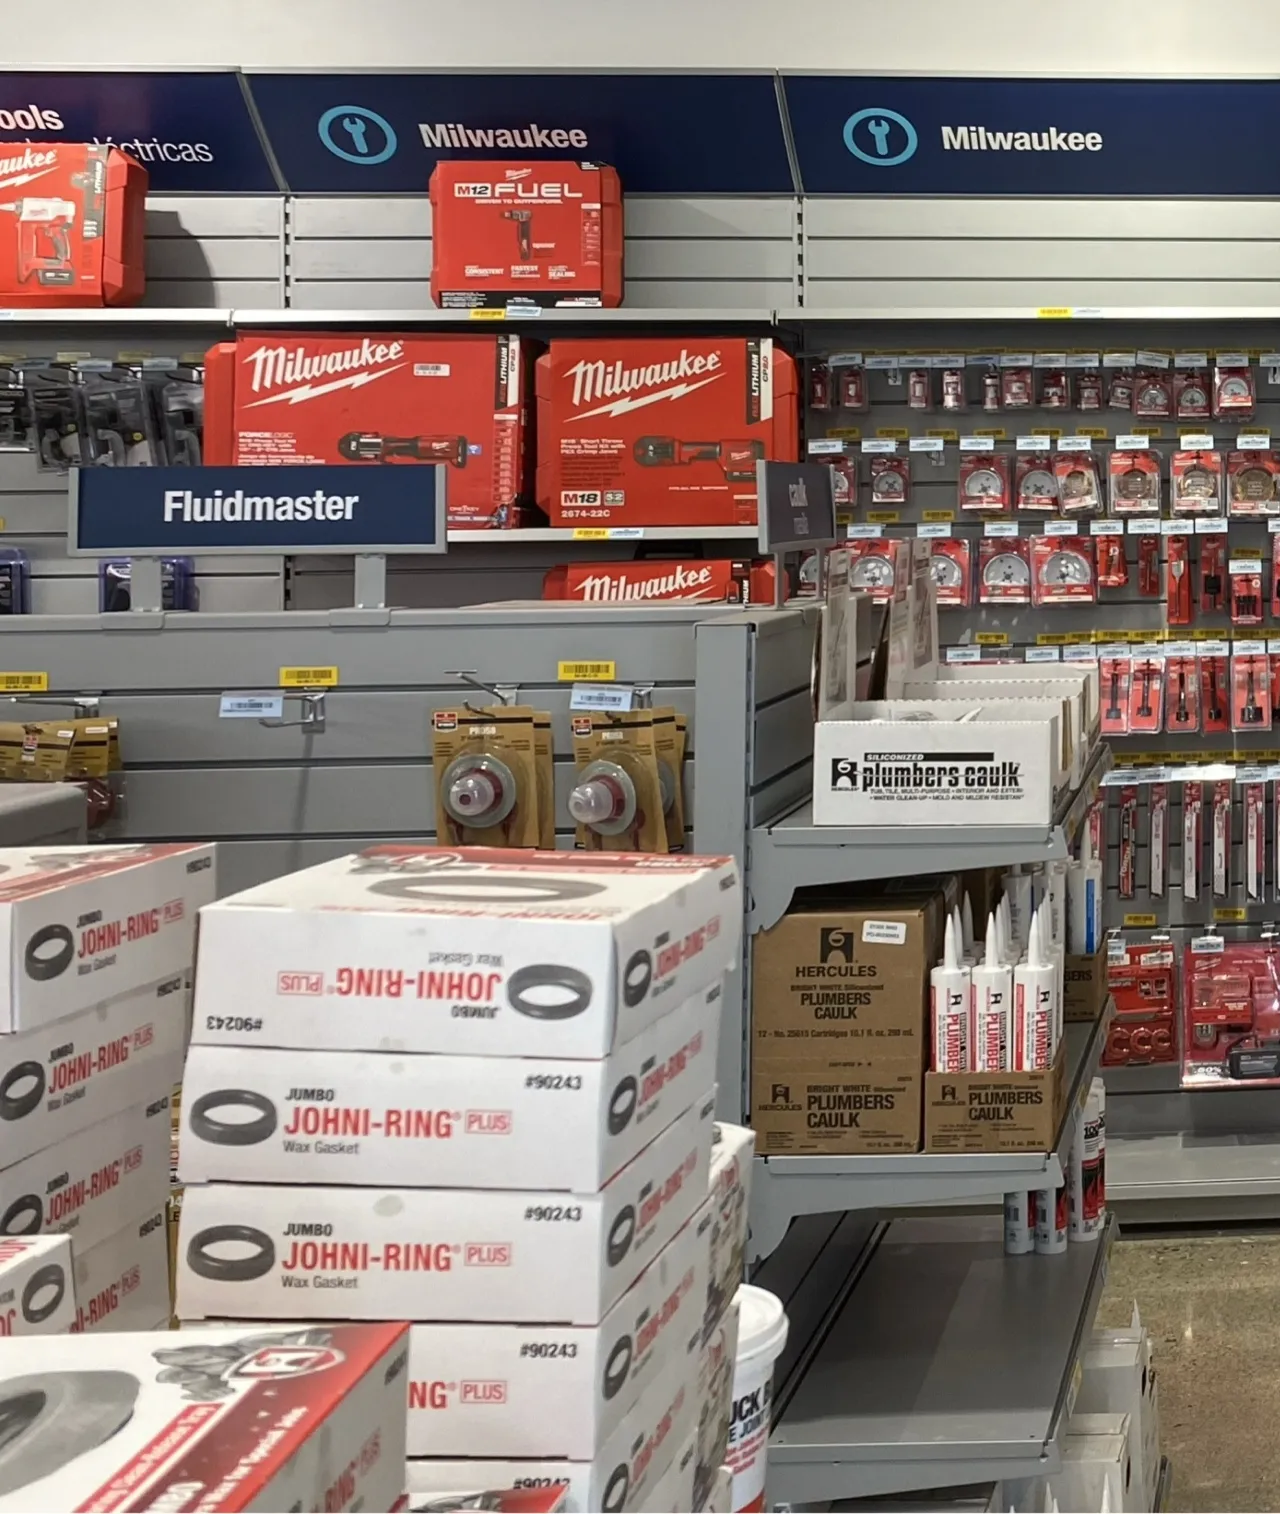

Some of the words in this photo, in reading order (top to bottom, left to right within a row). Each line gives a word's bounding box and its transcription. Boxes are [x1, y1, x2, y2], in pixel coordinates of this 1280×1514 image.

[0, 104, 64, 131] ools
[419, 122, 588, 149] Milwaukee
[941, 125, 1104, 154] Milwaukee
[84, 137, 213, 162] ctricas
[0, 148, 57, 177] aukee
[456, 185, 490, 196] M12
[494, 183, 583, 198] FUEL
[242, 338, 404, 392] Milwaukee
[562, 349, 722, 406] Milwaukee
[163, 490, 359, 522] Fluidmaster
[562, 492, 599, 504] M18
[561, 509, 611, 518] 2674-22C
[573, 566, 712, 601] Milwaukee
[866, 753, 925, 762] SILICONIZED
[862, 762, 959, 792] plumbers
[964, 761, 1020, 788] caulk
[78, 908, 160, 959] JOHNI-RING
[429, 952, 474, 966] Gasket
[795, 965, 877, 978] HERCULES
[1064, 970, 1092, 982] BERS
[279, 973, 321, 993] PLUS
[335, 967, 502, 1001] JOHNI-RING
[801, 992, 871, 1006] PLUMBERS
[450, 1005, 502, 1019] JUMBO
[814, 1006, 858, 1020] CAULK
[207, 1015, 263, 1032] #90243
[48, 1037, 130, 1094] JOHNI-RING
[525, 1074, 583, 1091] #90243
[807, 1085, 840, 1094] BRIGHT
[843, 1085, 871, 1093] WHITE
[284, 1088, 334, 1102] JUMBO
[807, 1094, 895, 1110] PLUMBERS
[968, 1091, 1043, 1106] PLUMBERS
[284, 1106, 455, 1138] JOHNI-RING
[467, 1112, 509, 1132] PLUS
[807, 1112, 860, 1128] CAULK
[968, 1106, 1014, 1121] CAULK
[283, 1141, 311, 1154] Wax
[314, 1140, 360, 1155] Gasket
[46, 1161, 121, 1225] JOHNI-RING
[525, 1206, 582, 1222] #90243
[283, 1223, 333, 1237] JUMBO
[282, 1242, 454, 1271] JOHNI-RING
[467, 1245, 509, 1265] PLUS
[281, 1276, 309, 1289] Wax
[312, 1275, 359, 1290] Gasket
[520, 1342, 577, 1359] #90243
[462, 1383, 505, 1401] PLUS
